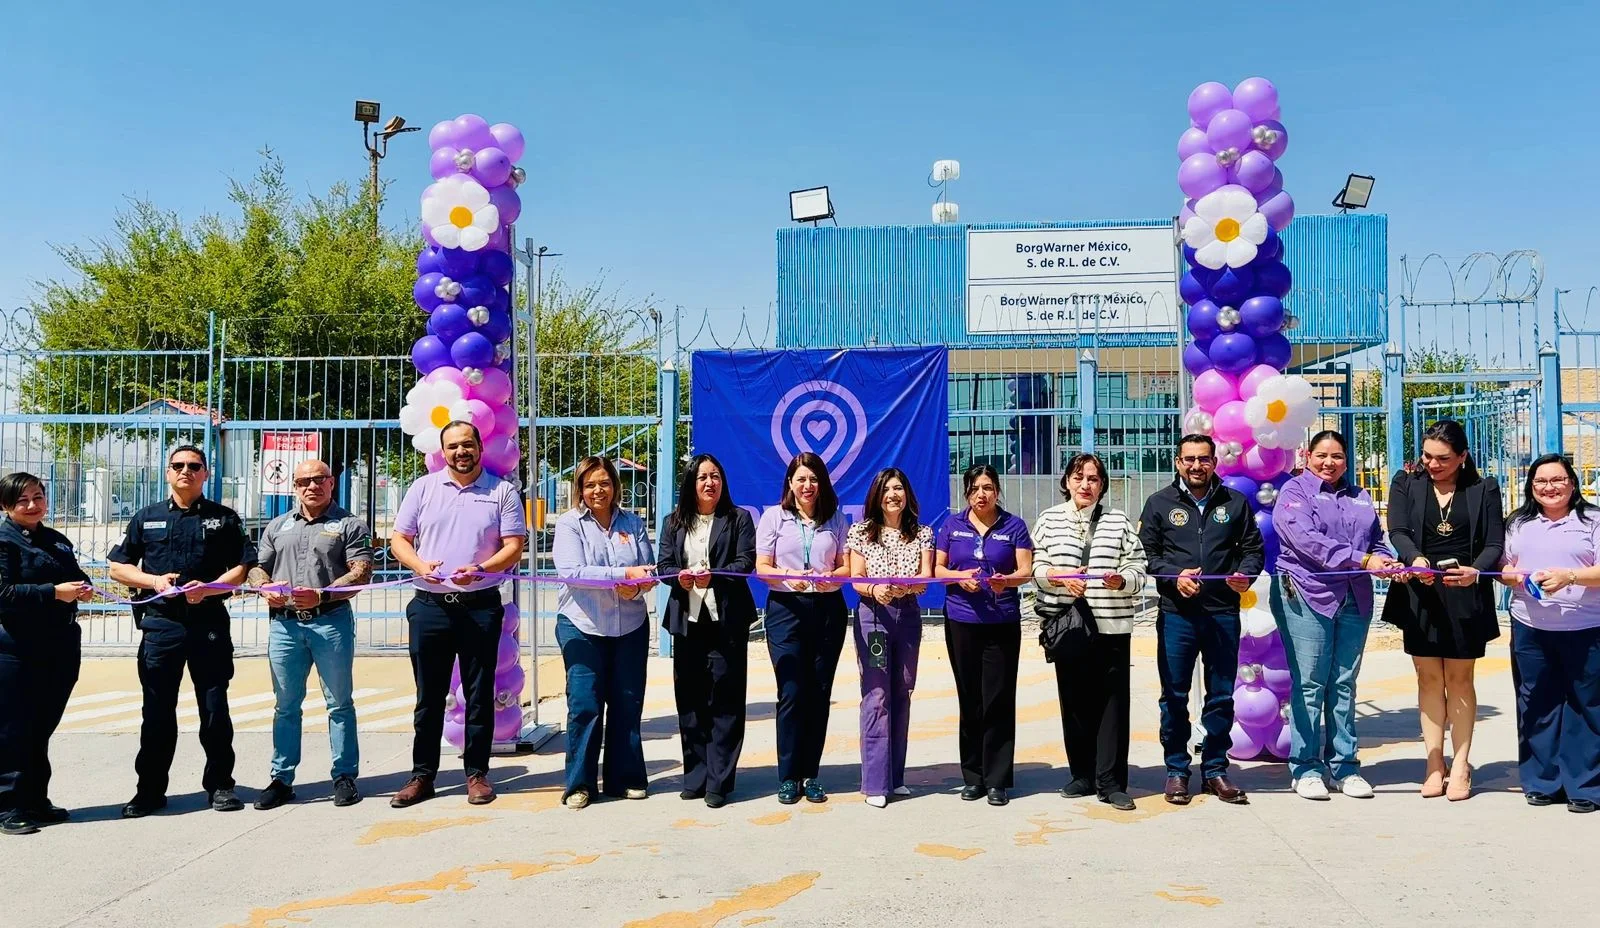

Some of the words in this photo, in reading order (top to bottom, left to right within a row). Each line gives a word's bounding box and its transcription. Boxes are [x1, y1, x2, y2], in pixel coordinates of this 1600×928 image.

[1016, 242, 1085, 254] BorgWarner
[1088, 241, 1131, 252] México,
[1026, 258, 1037, 268] S.
[1040, 257, 1054, 268] de
[1057, 257, 1079, 267] R.L.
[1081, 256, 1096, 267] de
[1099, 256, 1120, 266] C.V.
[1000, 295, 1069, 307] BorgWarner
[1104, 293, 1147, 305] México,
[1026, 311, 1037, 320] S.
[1039, 311, 1053, 320] de
[1057, 310, 1078, 320] R.L
[1082, 310, 1096, 320] de
[1099, 310, 1119, 320] C.V.
